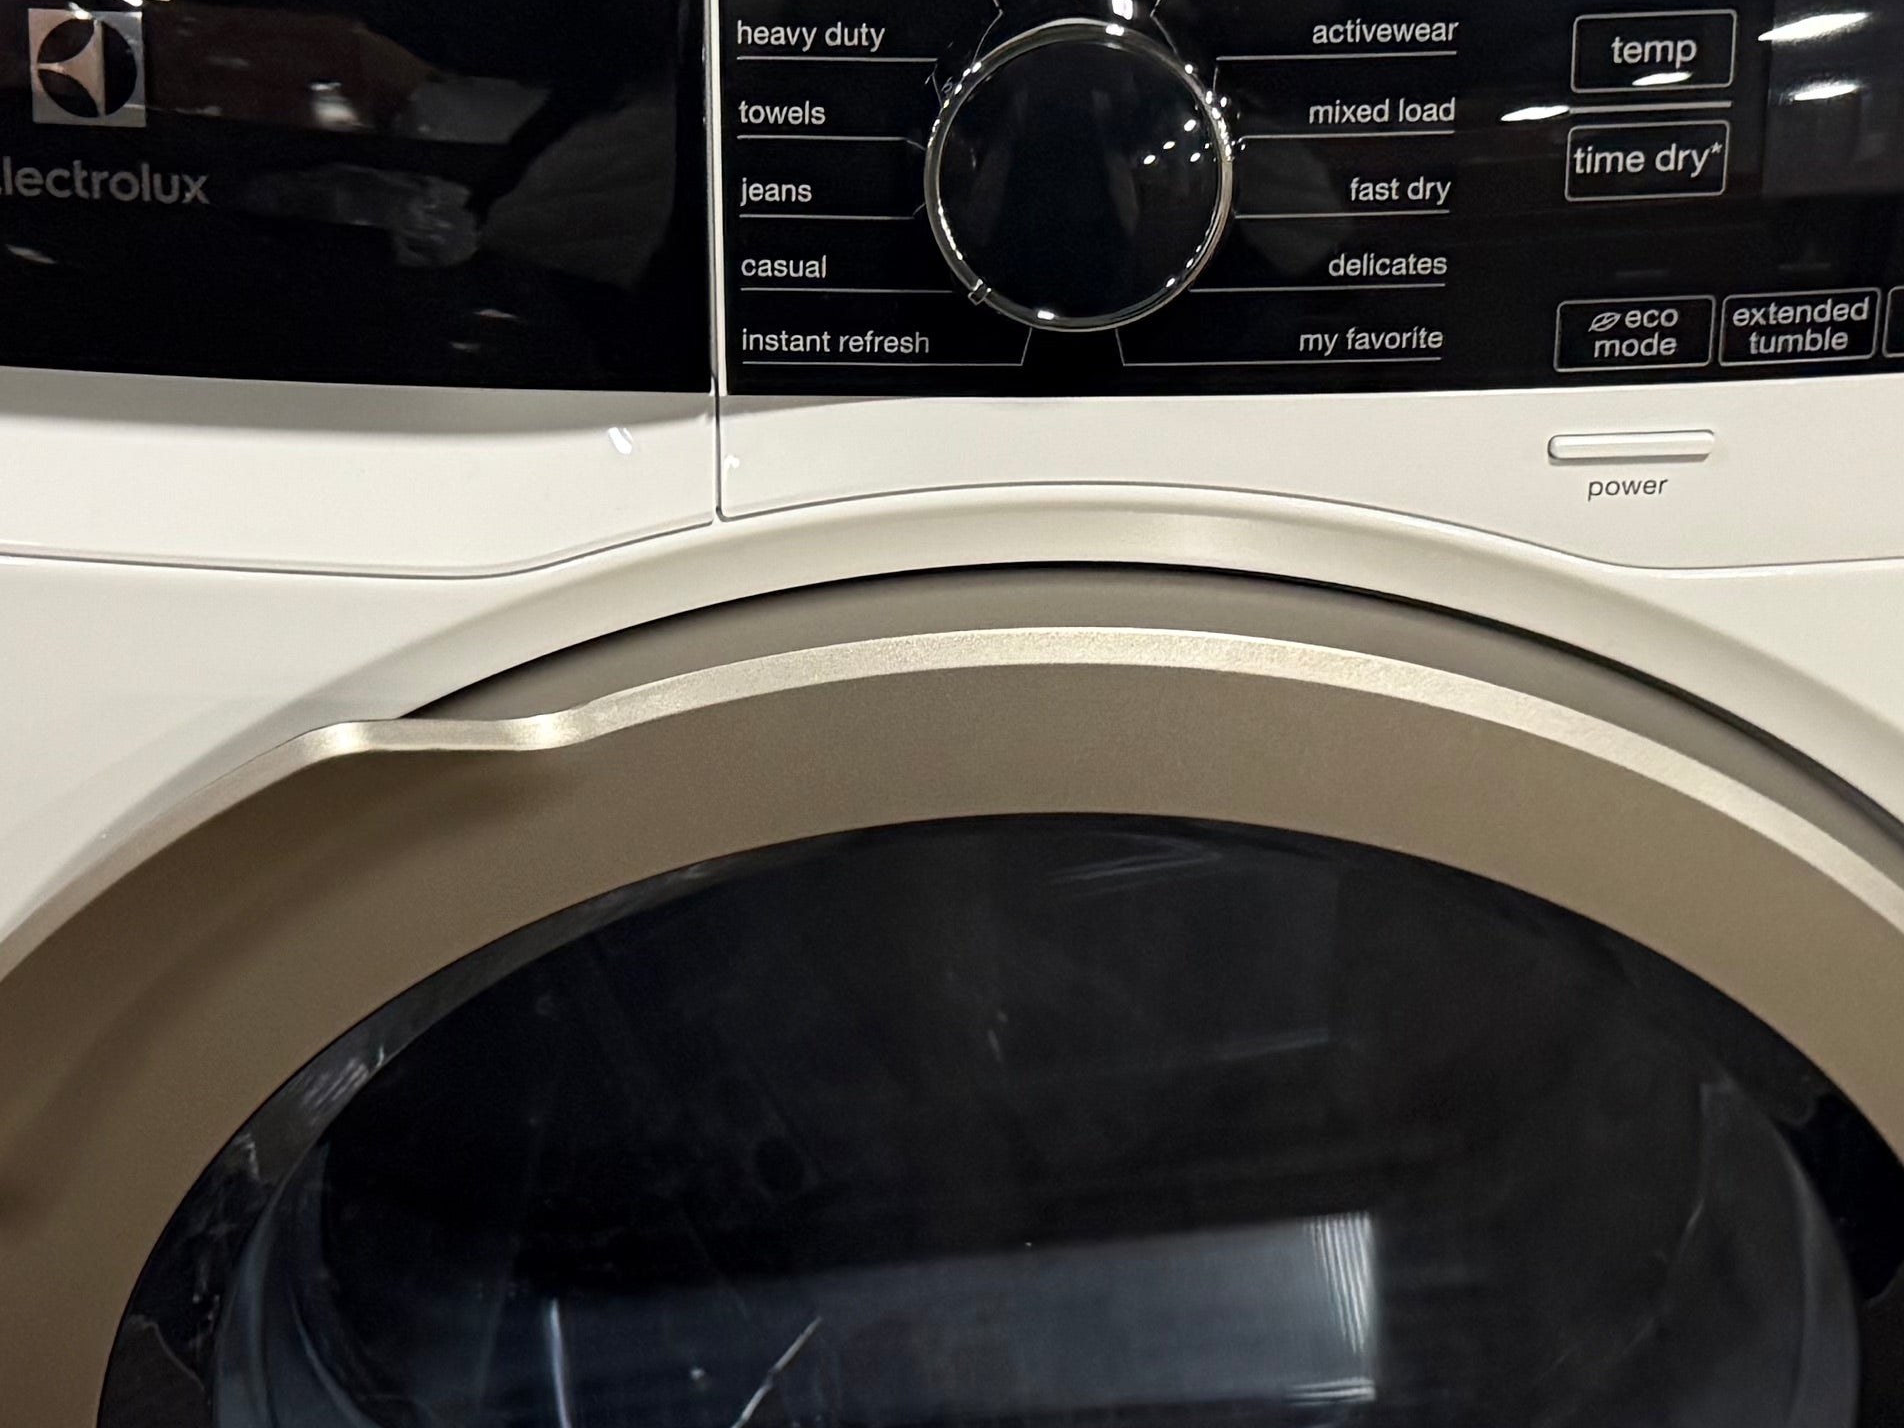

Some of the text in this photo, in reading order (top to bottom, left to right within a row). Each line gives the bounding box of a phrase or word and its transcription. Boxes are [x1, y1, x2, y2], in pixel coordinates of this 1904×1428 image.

[737, 19, 886, 53] heavy duty
[1312, 18, 1460, 45] activewear
[1610, 33, 1697, 70] temp
[738, 100, 826, 125] towels
[1308, 96, 1456, 124] mixed load
[1572, 142, 1650, 174] time
[739, 177, 813, 207] jeans
[1350, 175, 1452, 206] fast dry
[741, 254, 827, 279] casual
[1328, 252, 1448, 277] delicates
[1624, 305, 1680, 330] eco
[1731, 295, 1871, 327] extended
[742, 327, 929, 354] instant refresh
[1299, 326, 1444, 357] my favorite
[1592, 329, 1678, 358] mode
[1748, 324, 1850, 355] tumble
[1586, 474, 1669, 502] power
